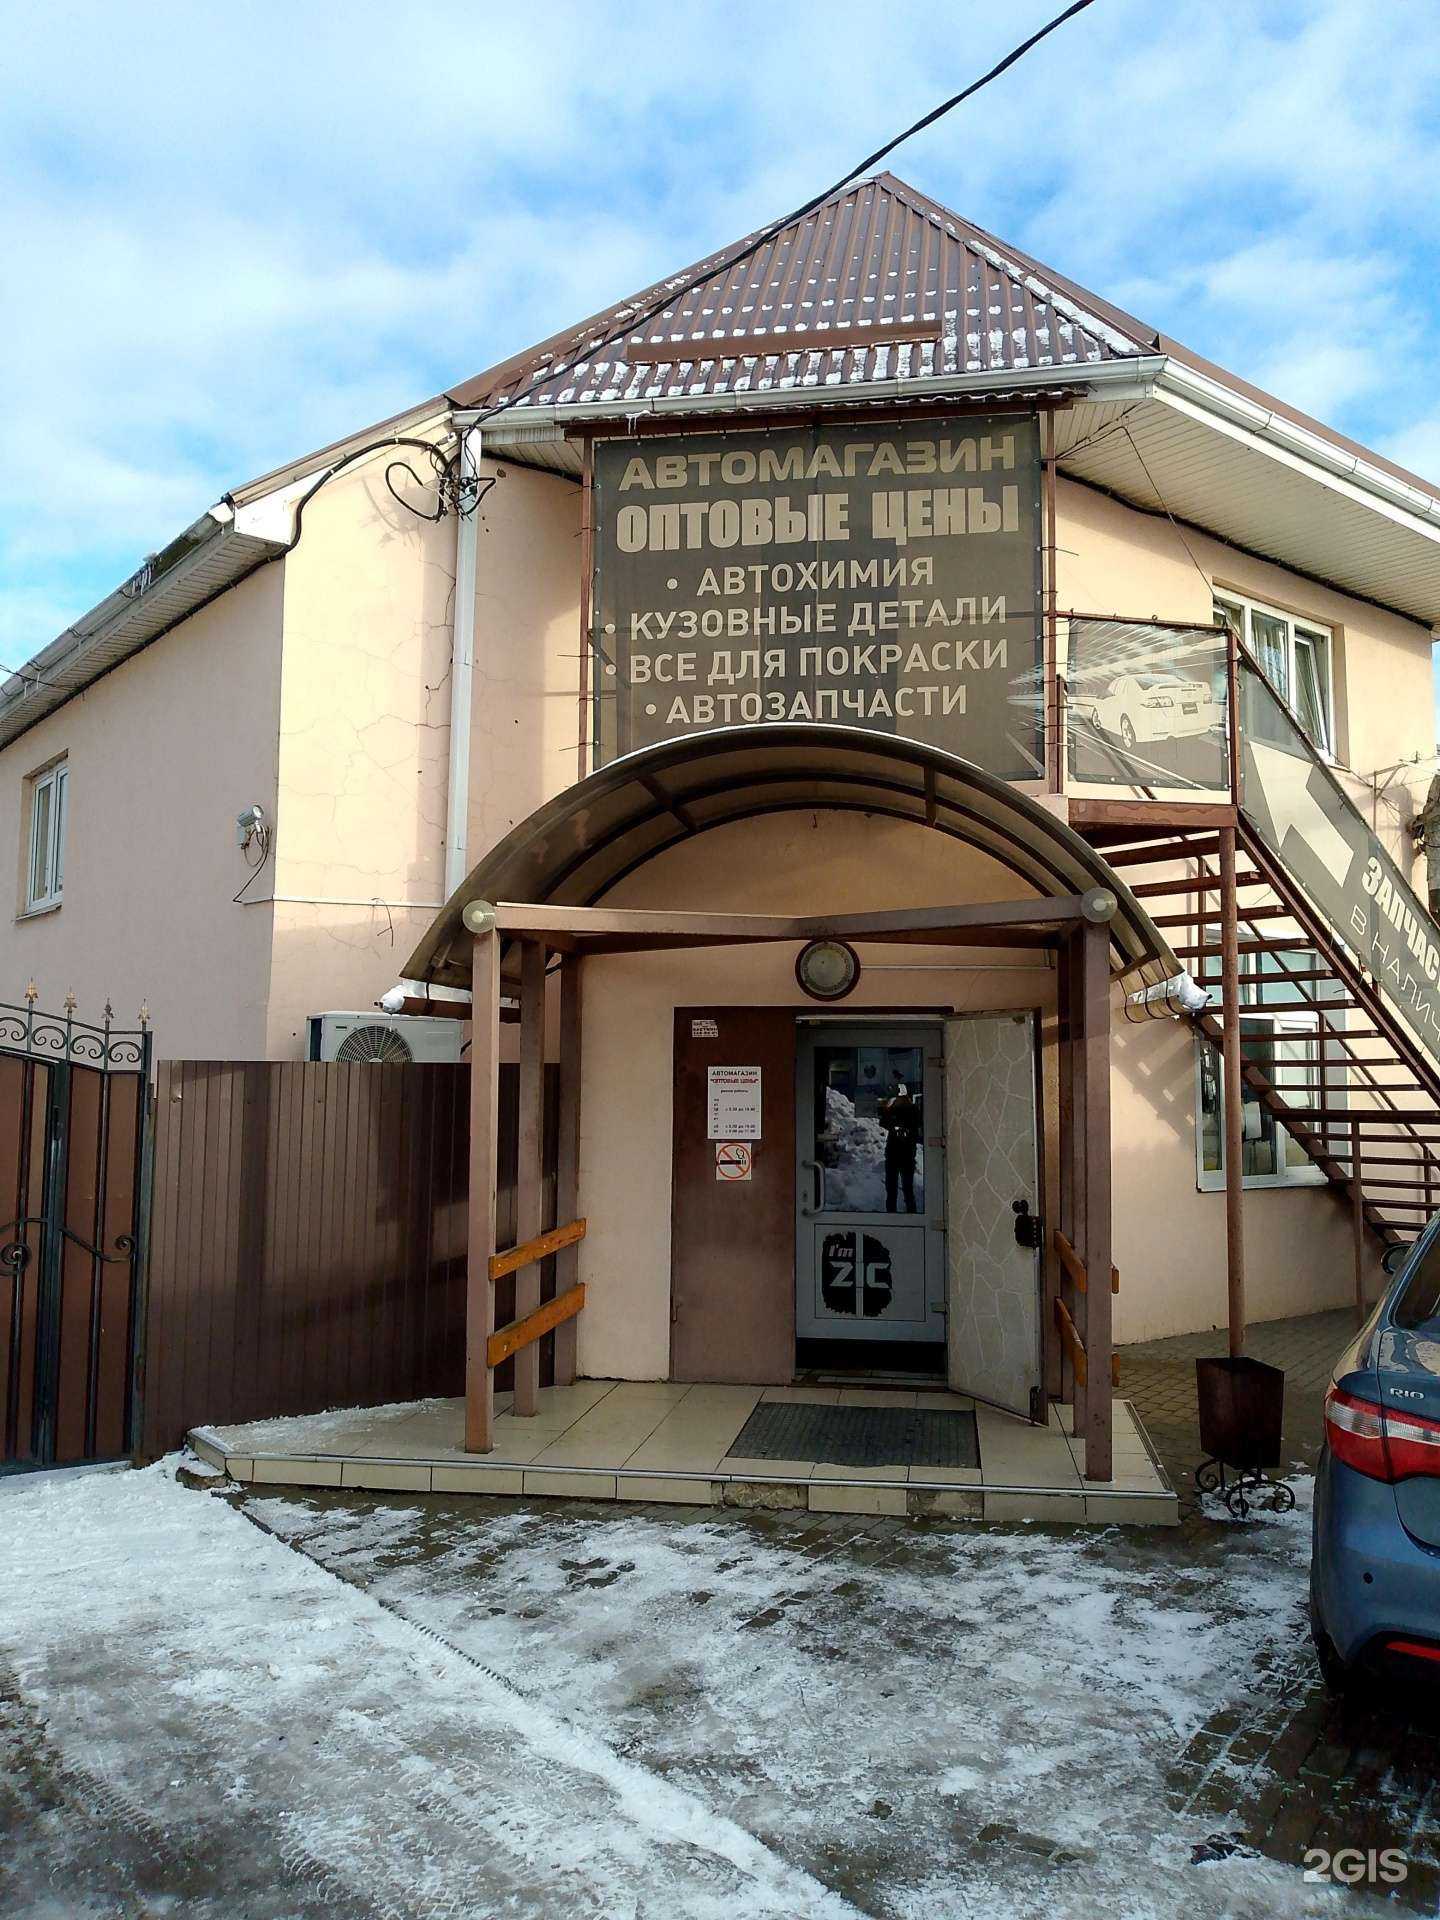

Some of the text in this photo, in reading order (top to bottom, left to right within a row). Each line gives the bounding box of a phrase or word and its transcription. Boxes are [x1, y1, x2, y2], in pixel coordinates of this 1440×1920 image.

[618, 435, 1016, 491] АВТОМАГАЗИН
[616, 485, 1019, 553] ОПТОВЫЕ ЦЕНЫ
[696, 556, 934, 597] АВТОХИМИЯ
[630, 595, 1007, 641] КУЗОВНЫЕ ДЕТАЛИ
[630, 638, 1008, 686] ВСЕ ДЛЯ ПОКРАСКИ
[665, 684, 967, 724] АВТОЗАПЧАСТИ
[1350, 904, 1367, 936] В
[1362, 856, 1440, 992] ЗАПЧАС
[829, 1244, 854, 1257] I'm
[1390, 1388, 1424, 1400] RIO
